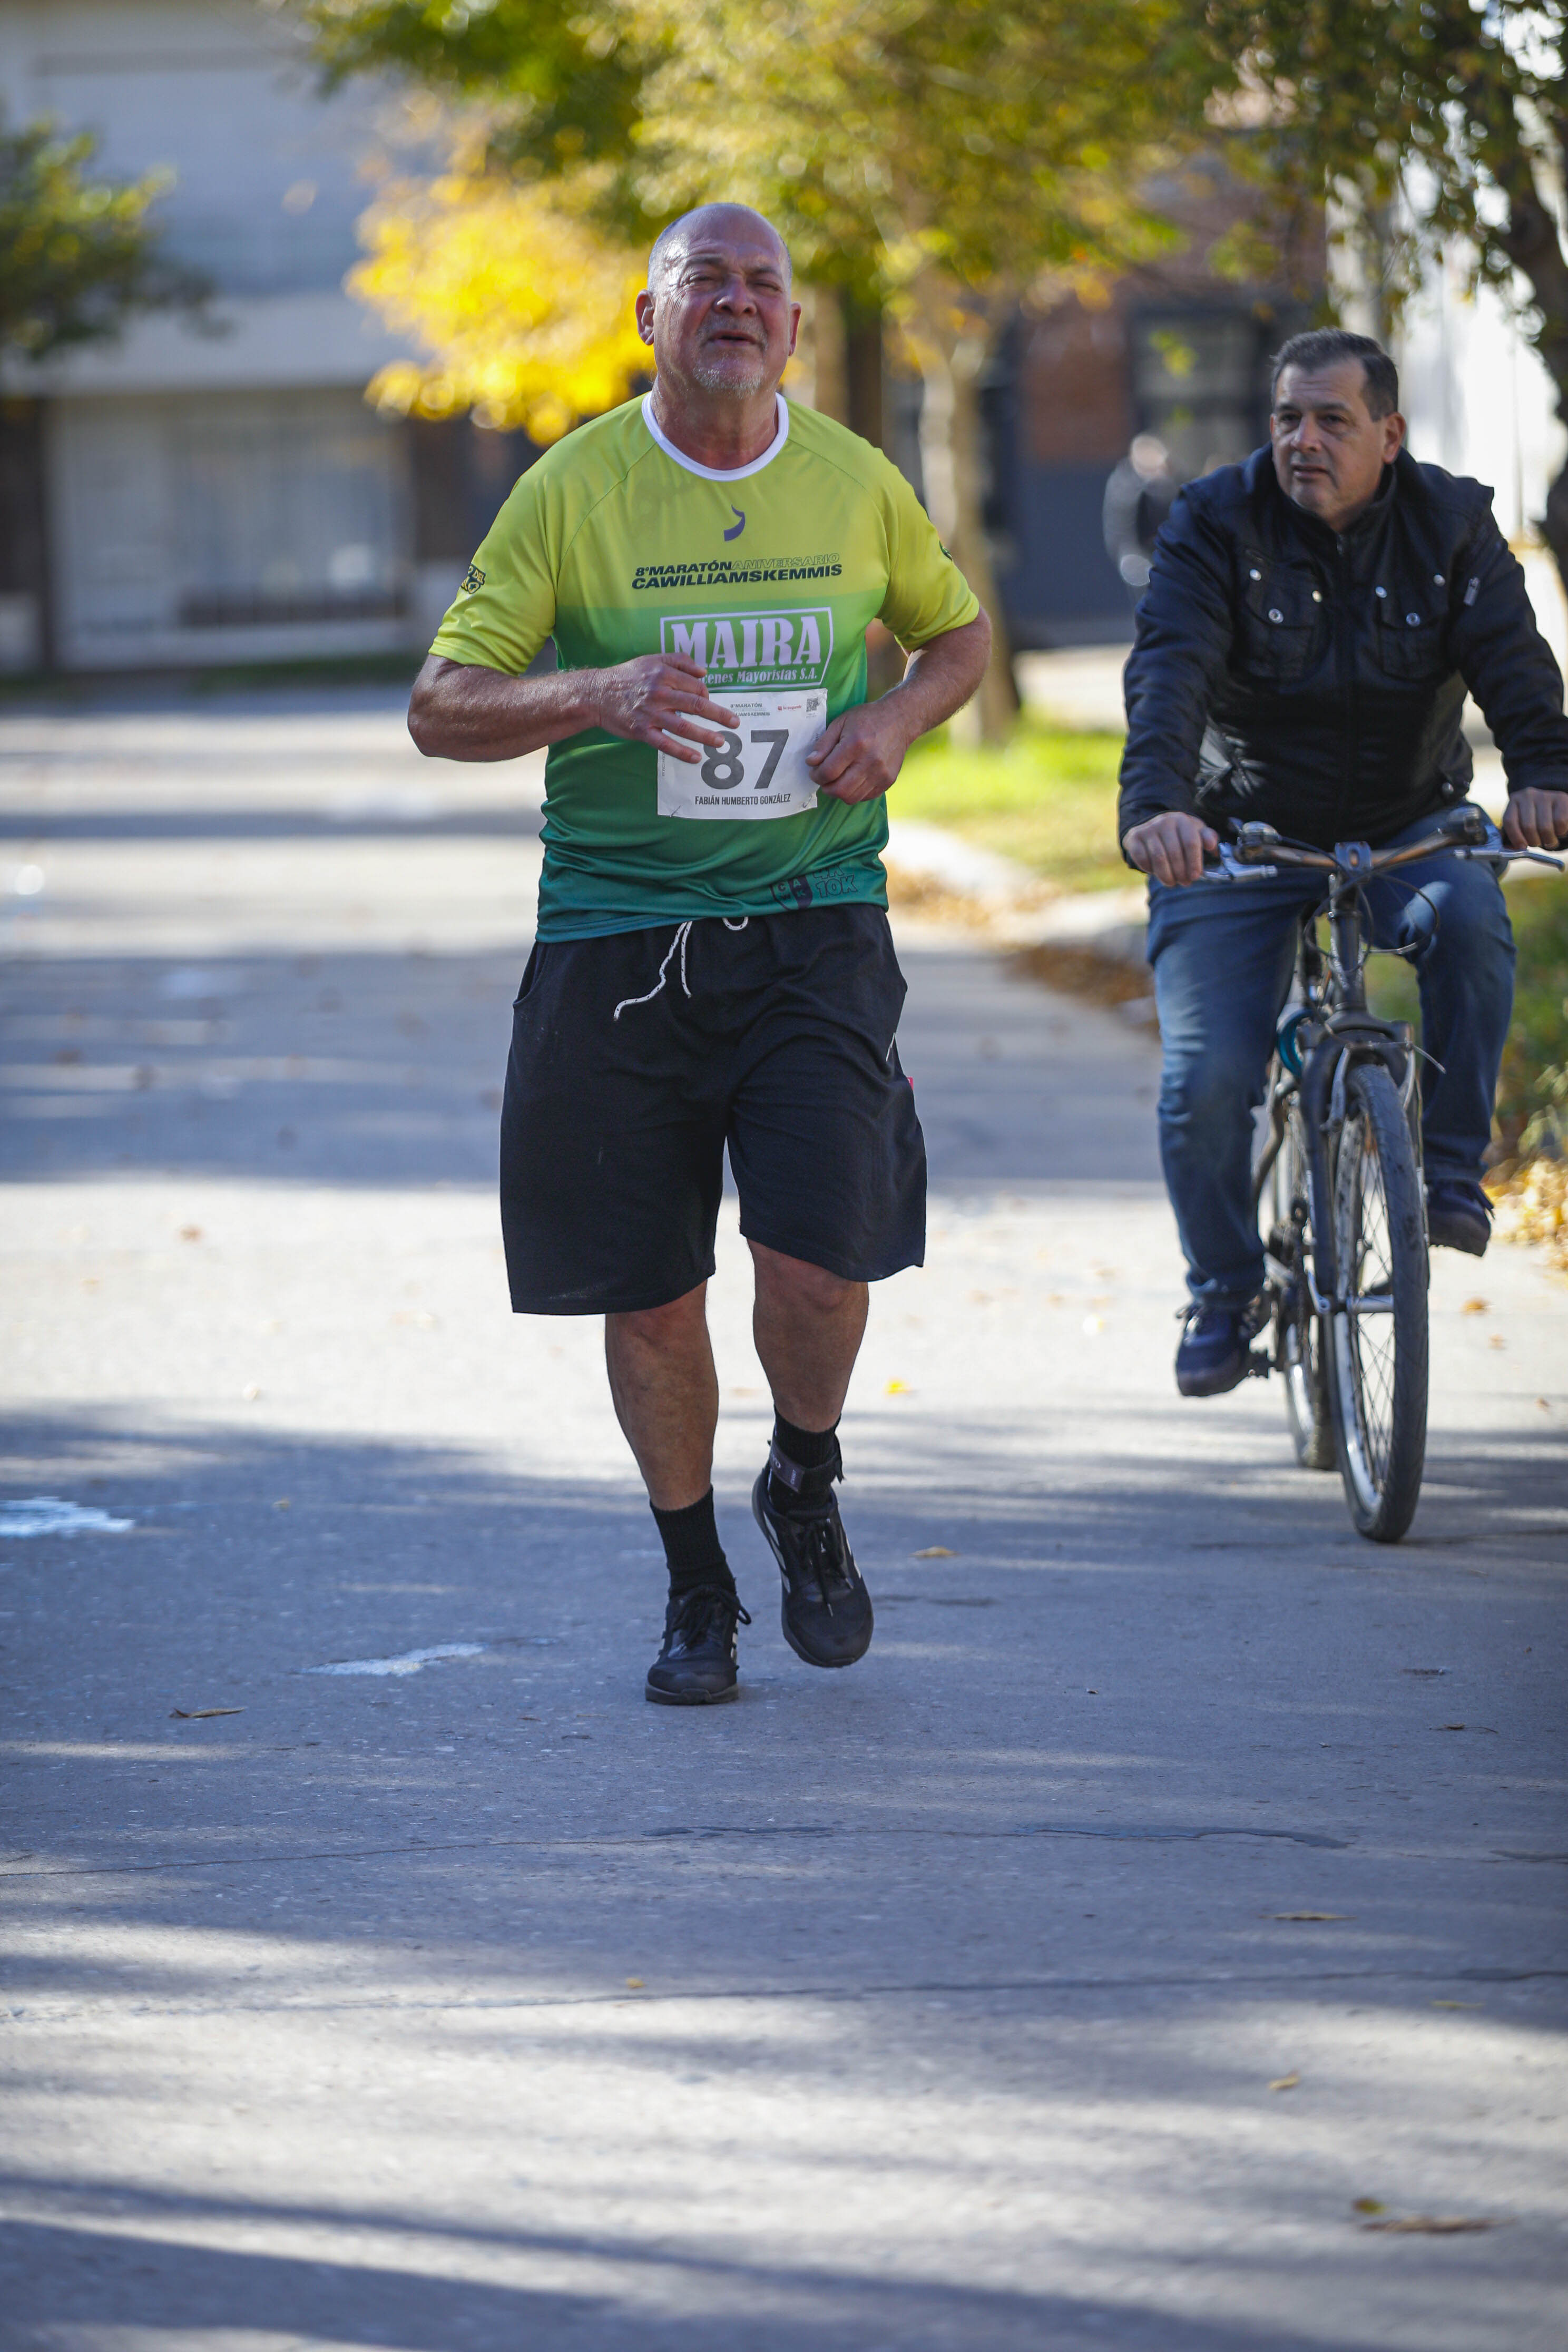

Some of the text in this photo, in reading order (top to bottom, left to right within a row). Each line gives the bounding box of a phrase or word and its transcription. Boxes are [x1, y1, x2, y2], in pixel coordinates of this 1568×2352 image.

[732, 553, 840, 571] ANIVERSARIO
[631, 563, 842, 590] CAWILLIAMSKEMMIS
[671, 615, 821, 669] MAIRA
[701, 667, 817, 686] cenes Mayoristas S.A.
[701, 729, 789, 790] 87
[695, 793, 791, 805] FABIÁN HUMBERTO GONZÁLEZ
[815, 874, 858, 898] 10K
